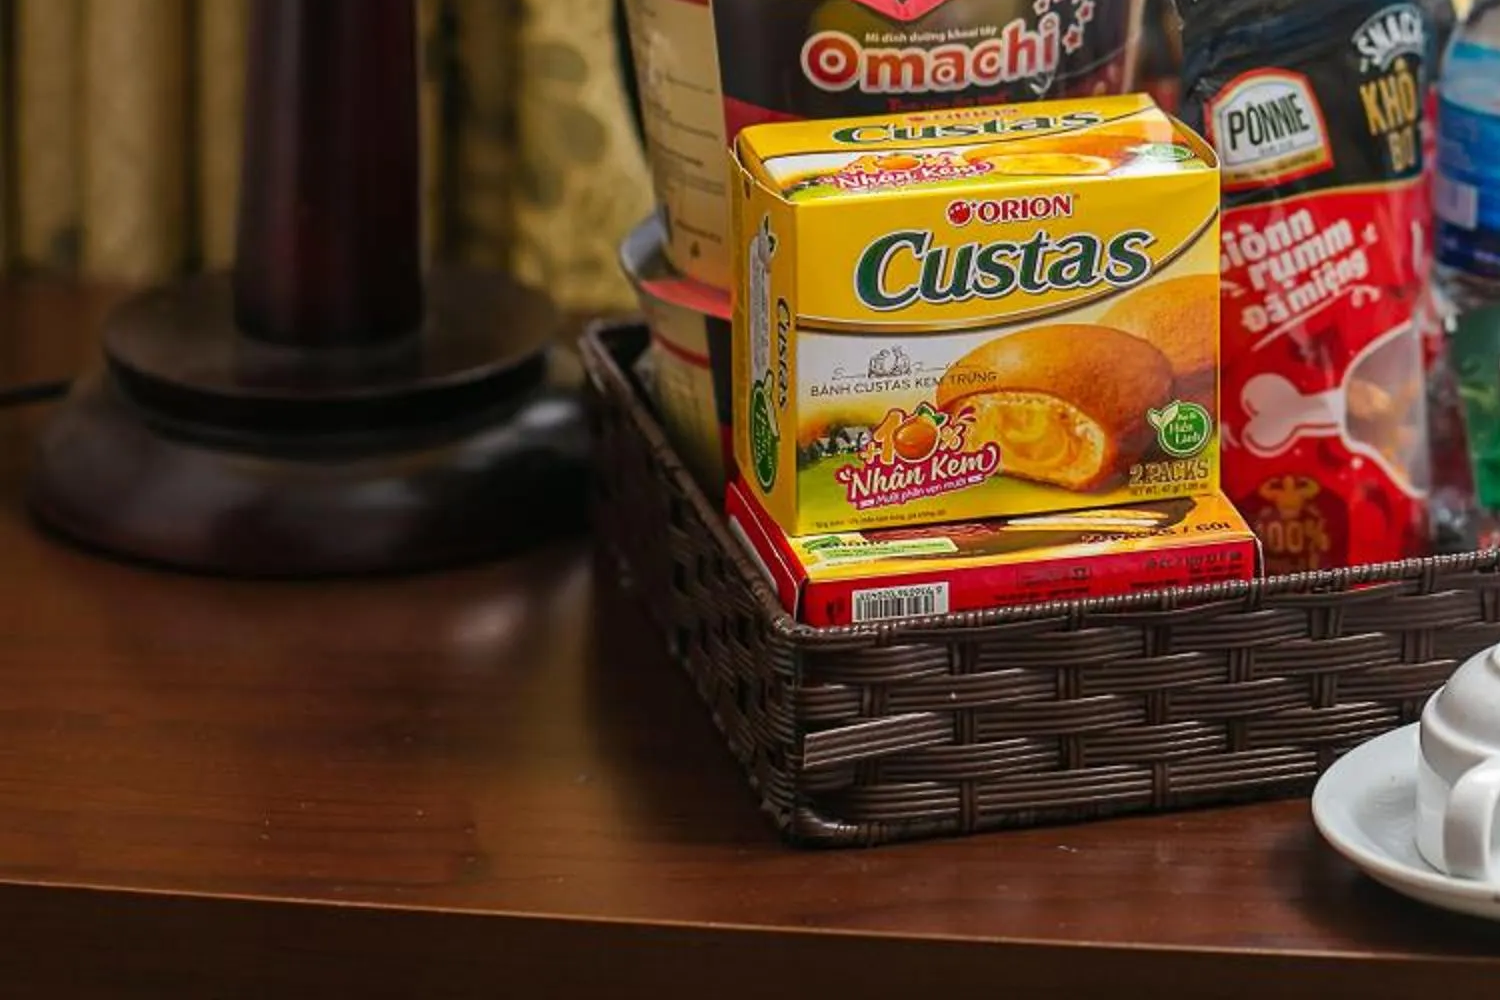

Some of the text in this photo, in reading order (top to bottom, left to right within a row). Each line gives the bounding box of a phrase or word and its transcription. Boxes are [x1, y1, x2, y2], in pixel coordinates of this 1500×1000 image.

[802, 12, 1060, 92] Omachi
[1359, 58, 1418, 137] KHÔ
[833, 111, 1102, 143] Custas
[977, 195, 1072, 222] ORION
[1220, 208, 1316, 273] iònn
[854, 229, 1157, 311] Custas
[853, 380, 911, 394] CUSTAS
[915, 376, 945, 388] KEM
[851, 442, 999, 500] Nhân Kem
[1145, 459, 1210, 484] PACKS
